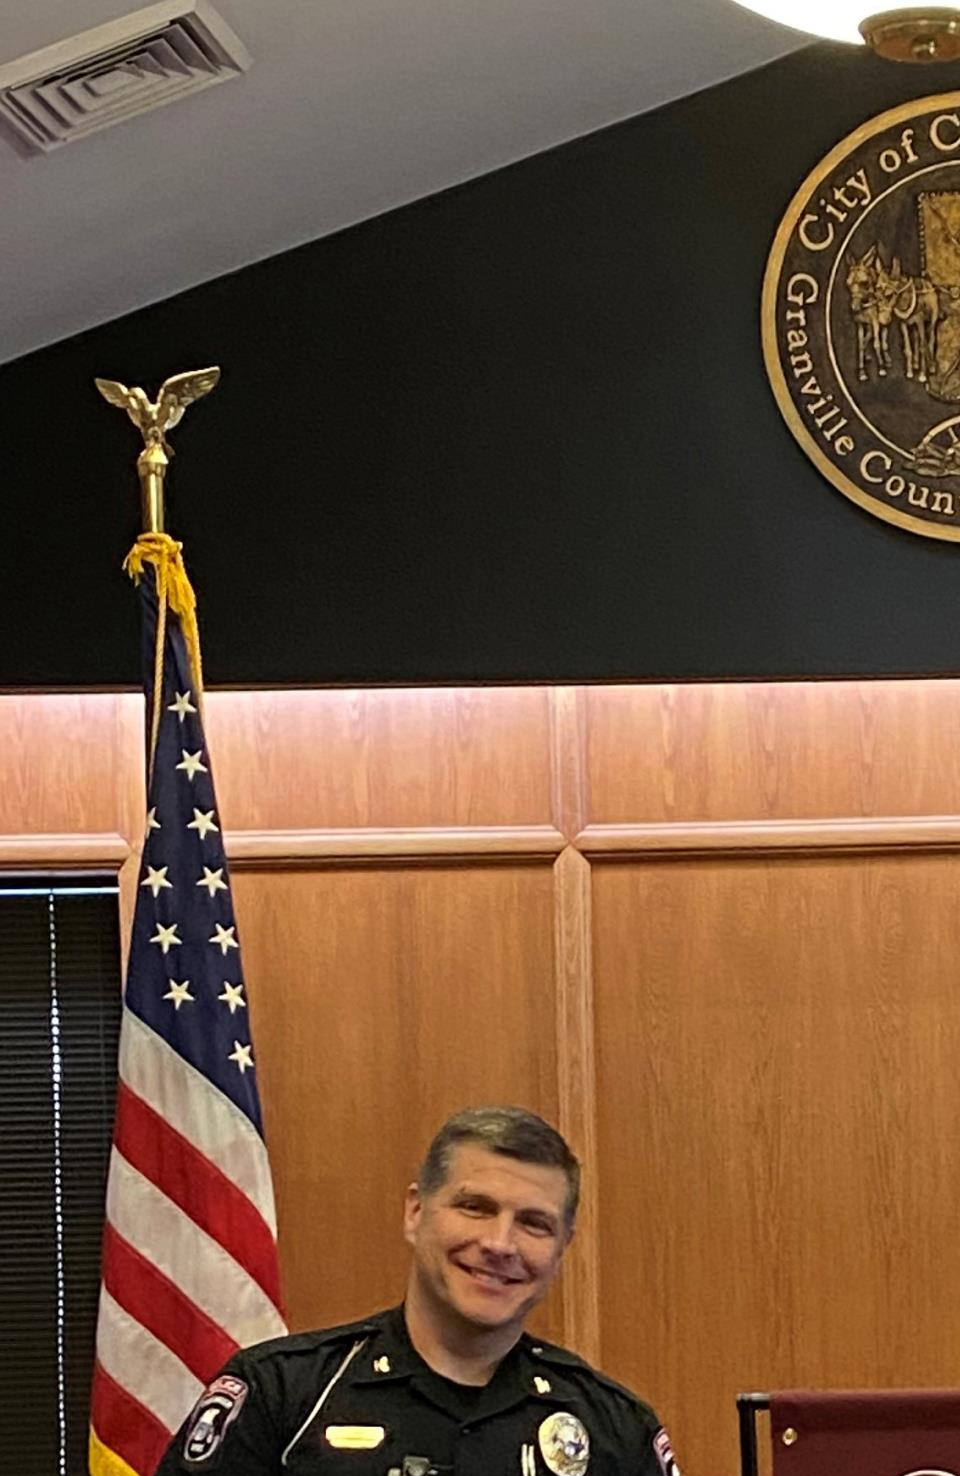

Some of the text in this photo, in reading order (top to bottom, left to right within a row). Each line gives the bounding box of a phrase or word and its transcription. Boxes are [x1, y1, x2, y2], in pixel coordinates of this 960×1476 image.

[800, 167, 873, 252] City
[879, 129, 919, 173] of
[785, 273, 856, 457] Granville
